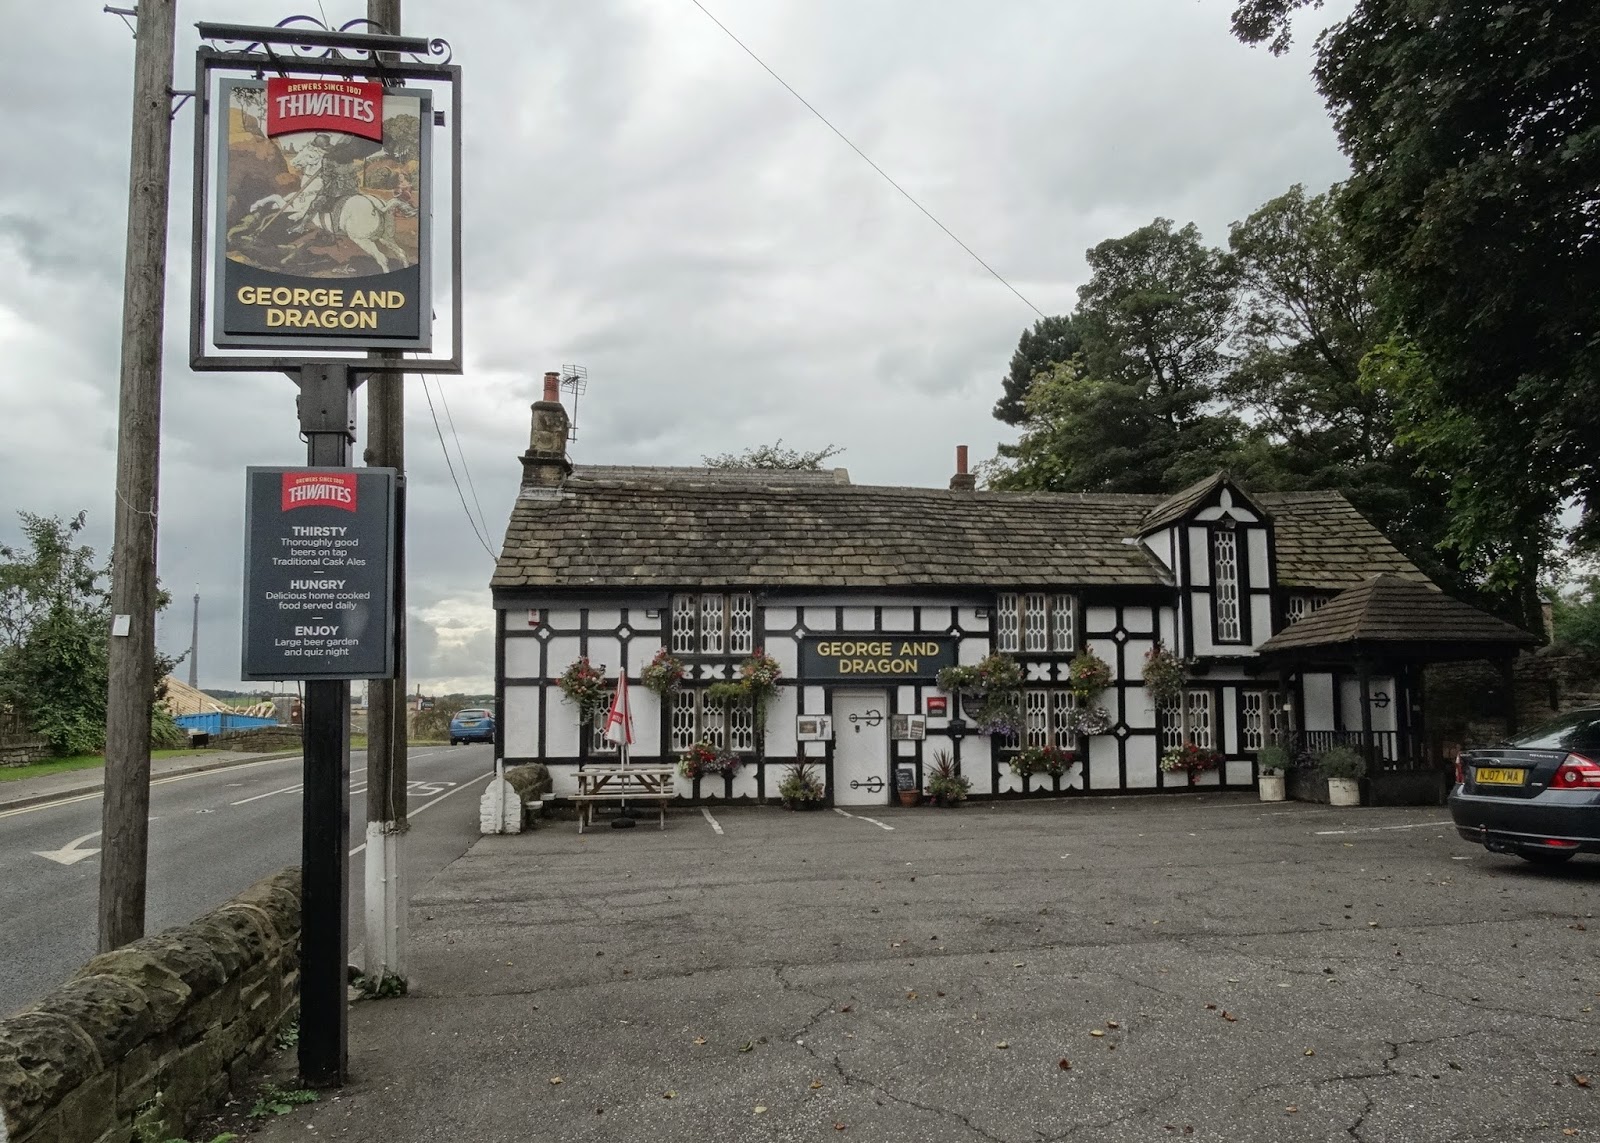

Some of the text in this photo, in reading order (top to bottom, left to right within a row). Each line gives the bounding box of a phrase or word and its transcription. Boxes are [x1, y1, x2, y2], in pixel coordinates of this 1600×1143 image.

[288, 83, 362, 95] BREWERS SINCE 1807
[276, 93, 375, 123] THWAITES
[237, 286, 405, 309] GEORGE AND
[266, 309, 378, 329] DRAGON
[288, 484, 352, 503] THWAITES
[292, 526, 347, 536] THIRSTY
[281, 538, 358, 548] Thoroughly good
[291, 548, 316, 556] beers
[332, 548, 347, 558] tap
[272, 557, 366, 566] Traditional Cask Ales
[290, 580, 346, 590] HUNGRY
[265, 591, 370, 600] Delicious home cooked
[278, 601, 357, 611] food served daily
[295, 626, 339, 636] ENJOY
[275, 638, 359, 648] Large beer garden
[284, 648, 349, 658] and quiz night
[817, 642, 939, 656] GEORGE AND
[839, 659, 918, 673] DRAGON
